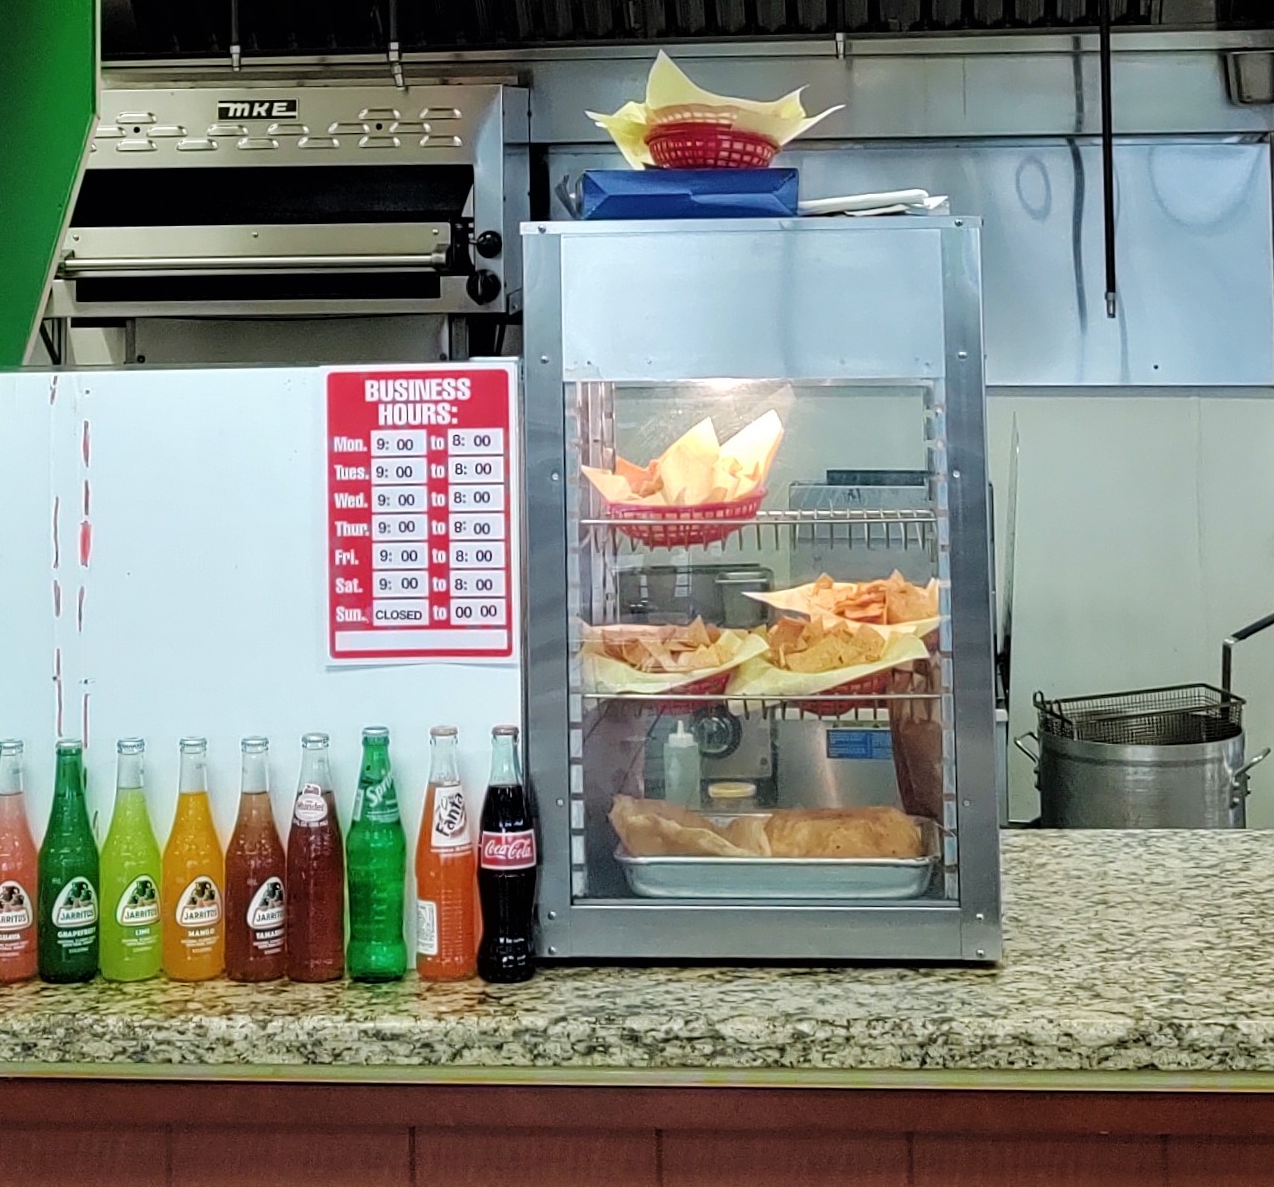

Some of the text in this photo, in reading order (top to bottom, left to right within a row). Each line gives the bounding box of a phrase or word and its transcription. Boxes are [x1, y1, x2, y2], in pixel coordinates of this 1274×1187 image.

[365, 378, 471, 402] BUSINESS
[379, 404, 457, 426] HOURS:
[334, 436, 367, 452] Mon.
[334, 464, 368, 480] Tues.
[334, 493, 368, 508] Wed.
[335, 522, 369, 537] Thur.
[335, 550, 358, 565] Fri.
[335, 578, 362, 593] Sat.
[336, 606, 422, 622] Sun. CLOSED
[435, 792, 465, 837] Fanta
